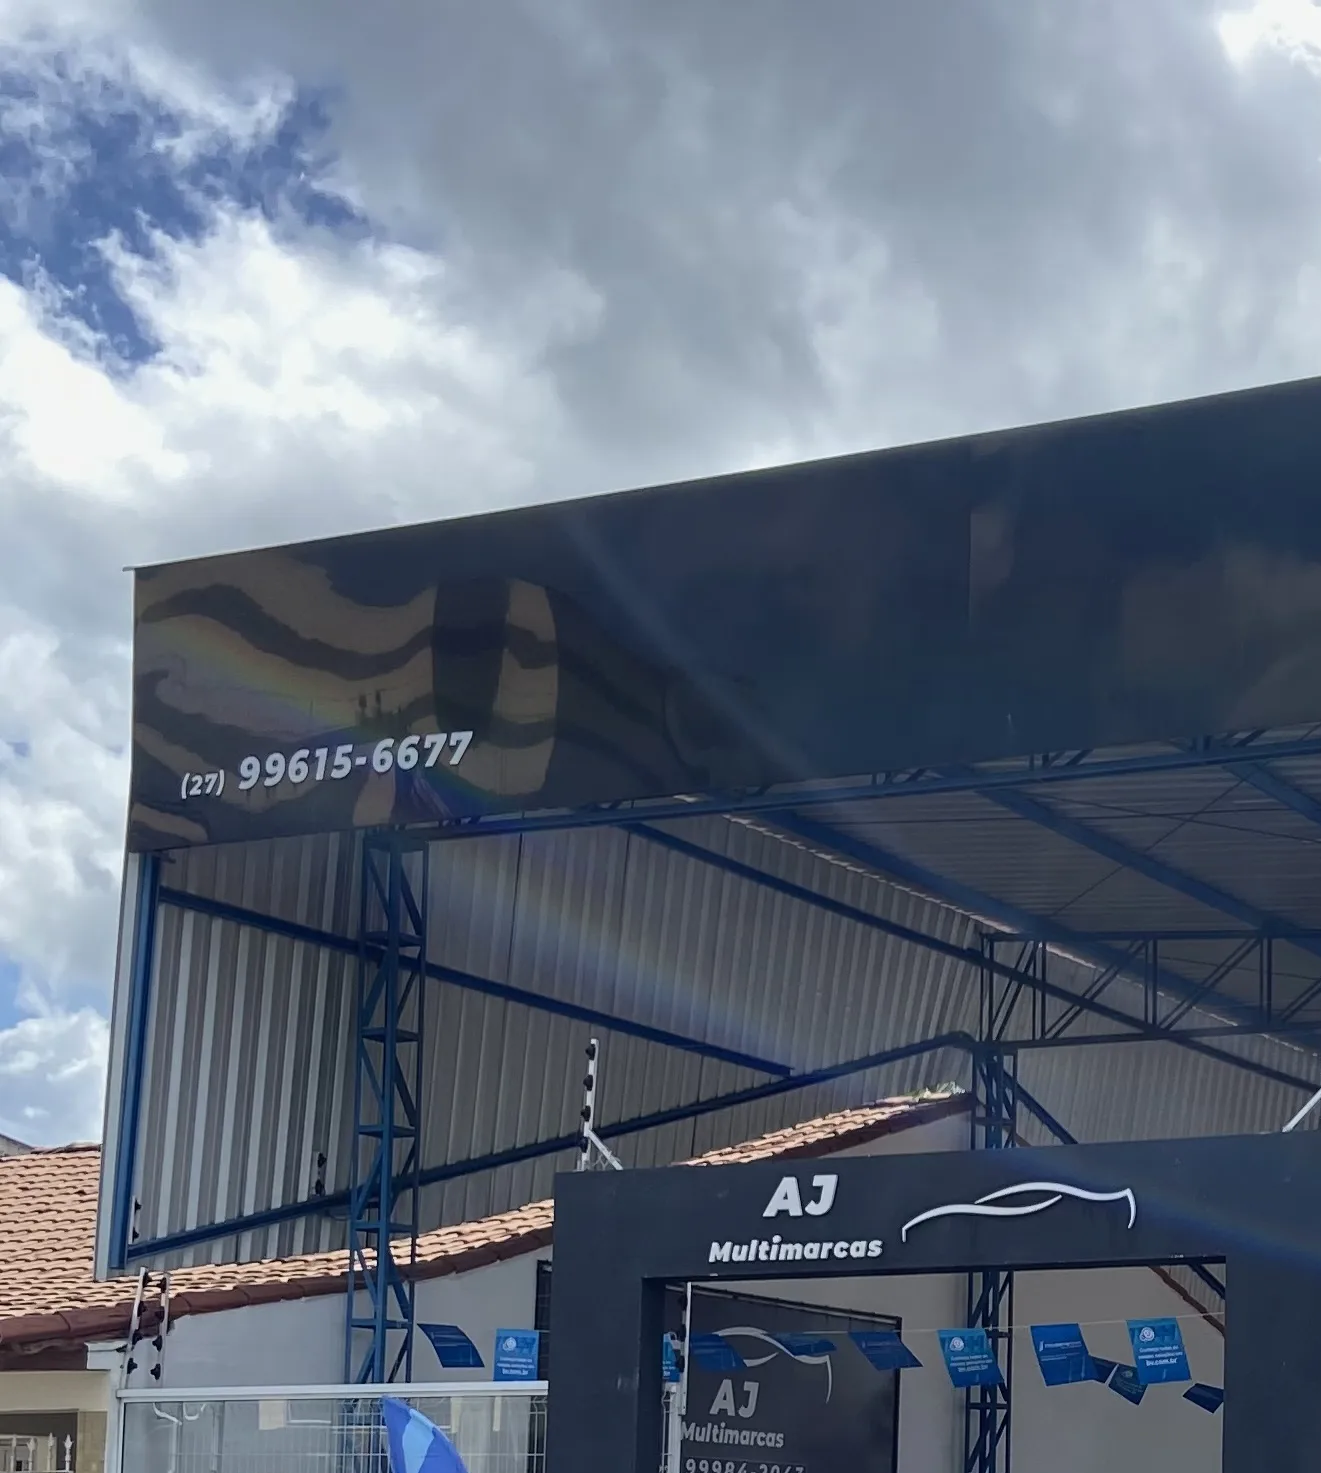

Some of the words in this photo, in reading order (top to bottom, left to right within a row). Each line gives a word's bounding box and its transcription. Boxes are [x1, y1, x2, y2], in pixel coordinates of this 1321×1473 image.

[180, 769, 225, 800] (27)
[238, 730, 474, 791] 99615-6677
[763, 1174, 839, 1218] AJ
[708, 1235, 884, 1264] Multimarcas
[709, 1378, 760, 1419] AJ
[680, 1421, 785, 1448] Multimarcas
